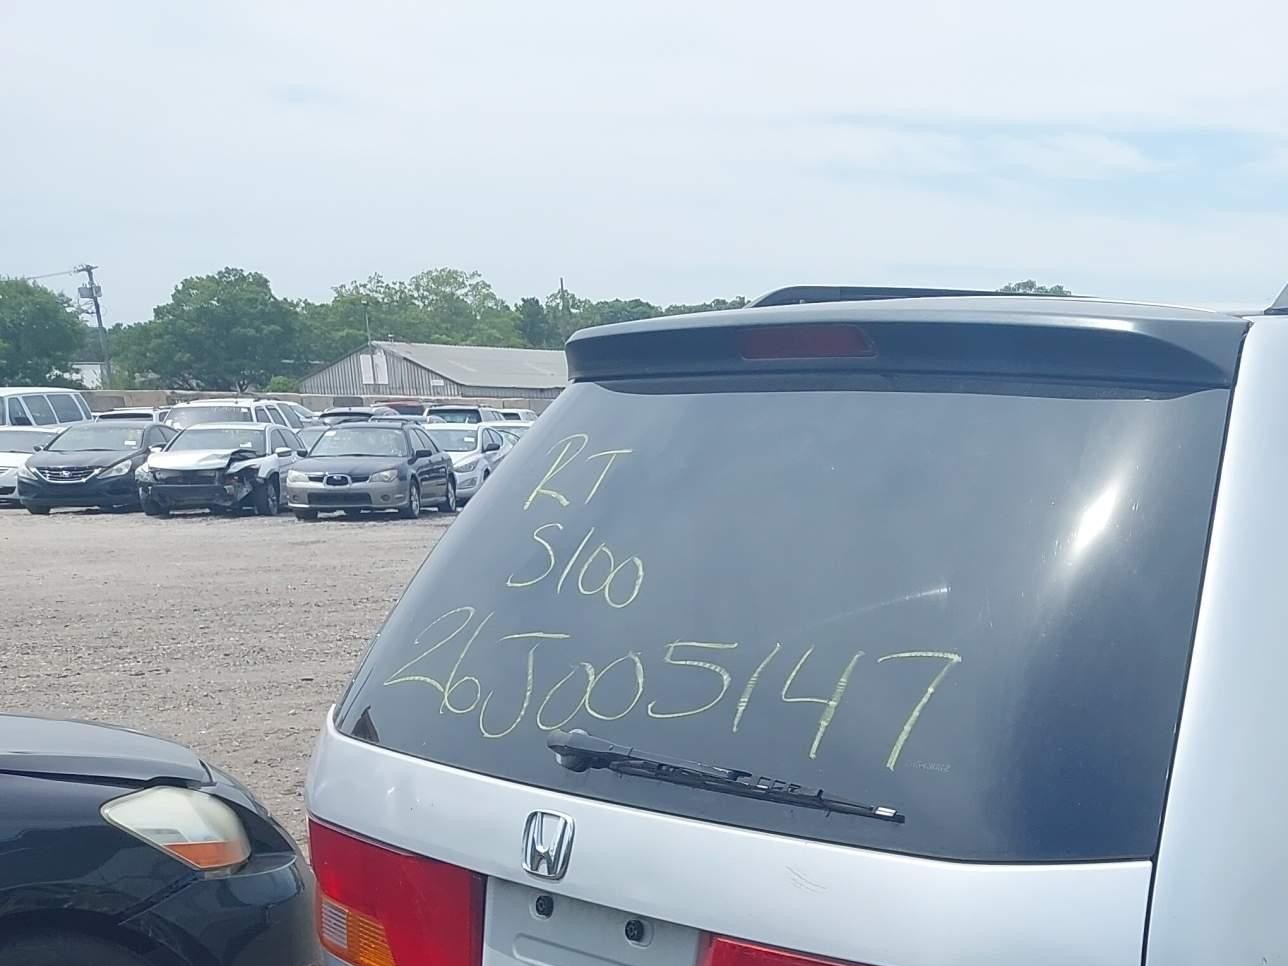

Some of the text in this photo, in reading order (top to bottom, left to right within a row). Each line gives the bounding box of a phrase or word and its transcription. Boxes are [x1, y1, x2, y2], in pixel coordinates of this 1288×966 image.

[524, 433, 632, 510] RT
[506, 522, 644, 608] S100
[383, 605, 962, 771] 26J005147
